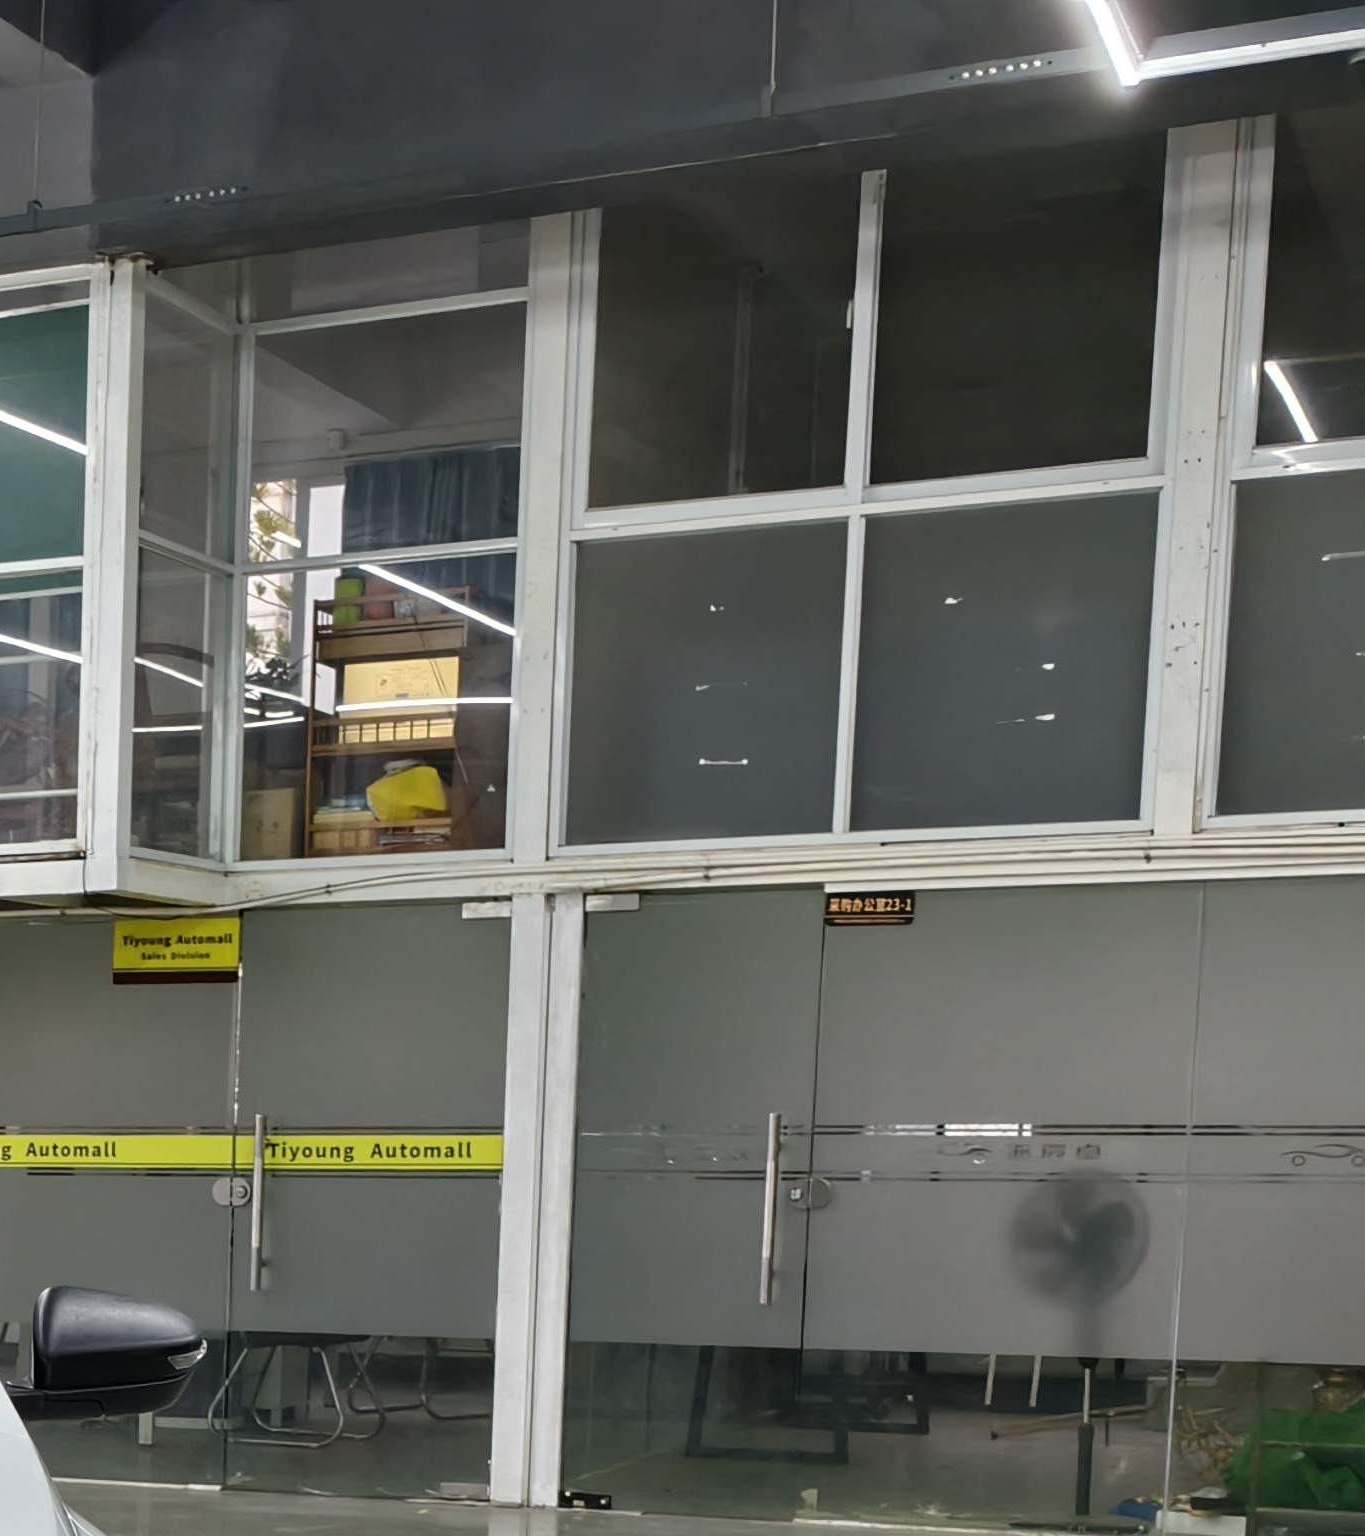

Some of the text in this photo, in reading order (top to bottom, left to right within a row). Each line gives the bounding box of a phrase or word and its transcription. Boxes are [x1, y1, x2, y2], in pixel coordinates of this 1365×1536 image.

[122, 932, 233, 948] Tiyoung Automall
[141, 951, 211, 961] Sales Division
[25, 1141, 117, 1158] Automall
[268, 1141, 473, 1162] Tiyoung Automall
